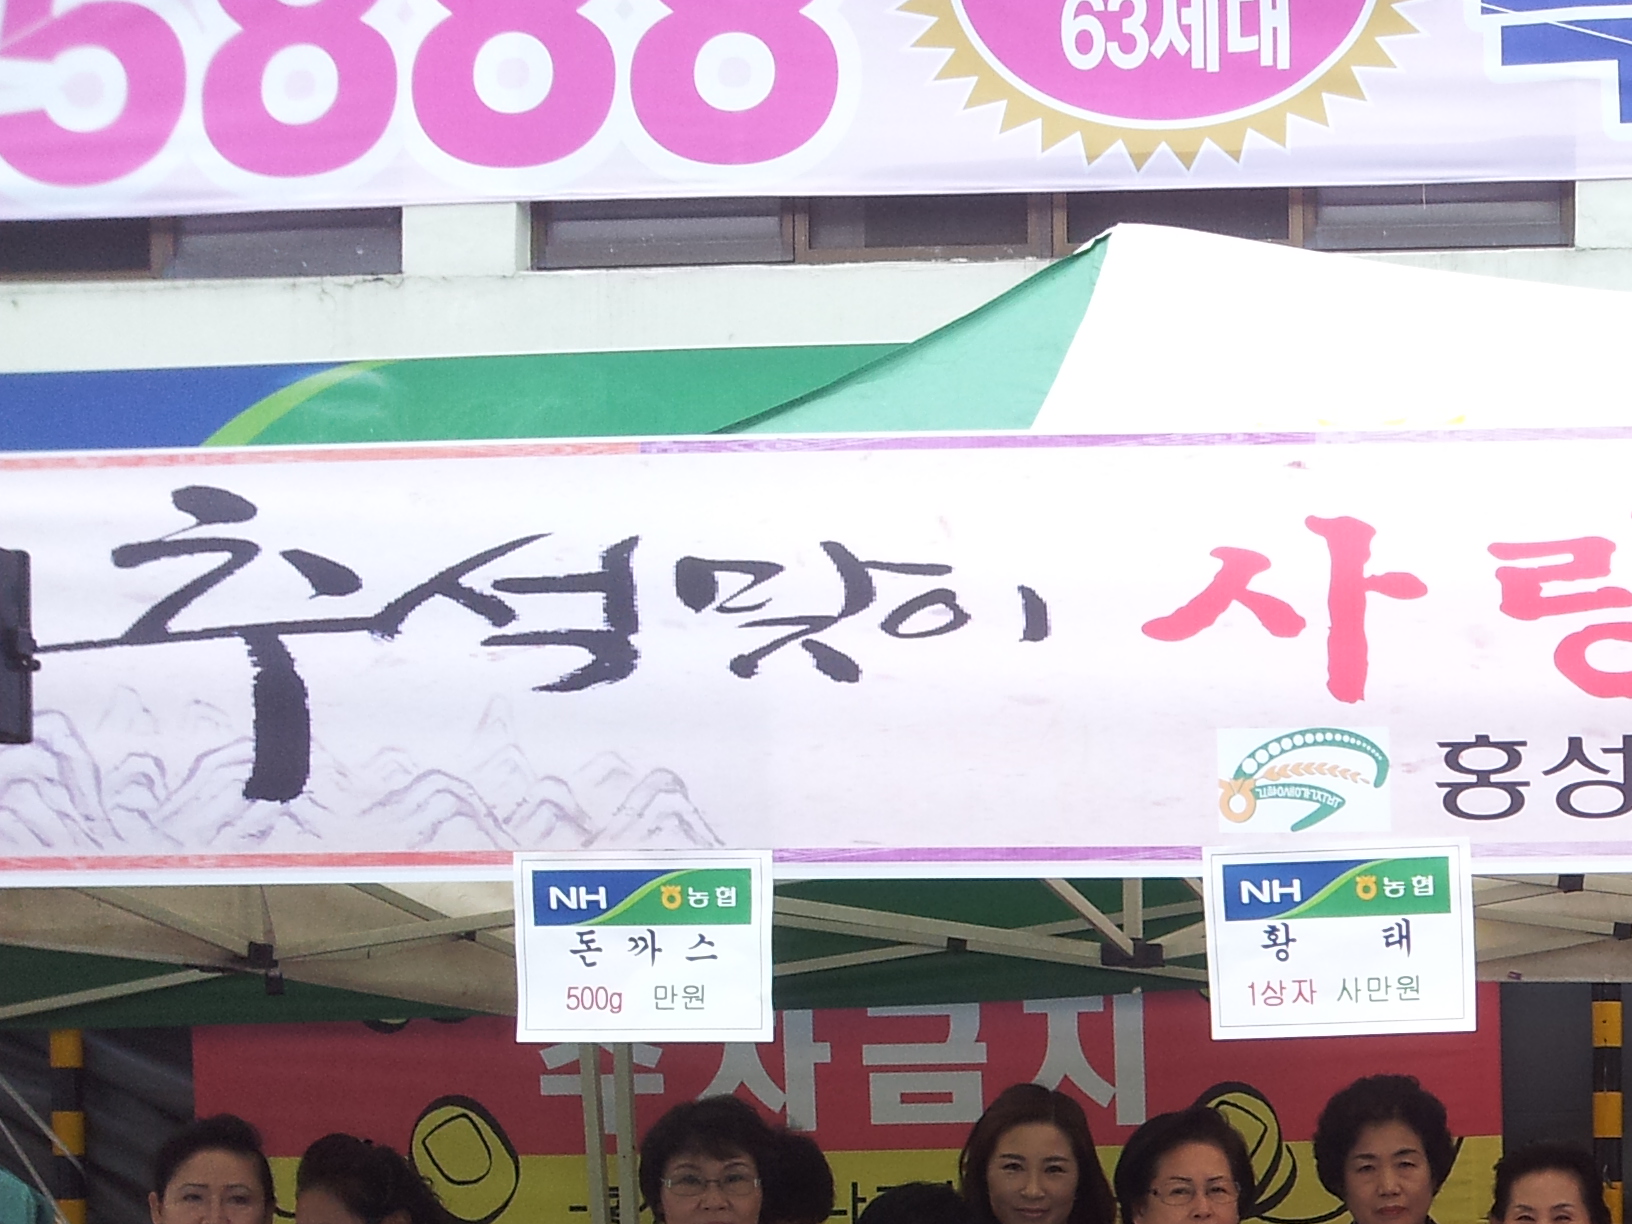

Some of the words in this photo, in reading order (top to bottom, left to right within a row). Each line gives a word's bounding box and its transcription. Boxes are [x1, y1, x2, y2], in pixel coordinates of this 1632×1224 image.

[30, 485, 1049, 802] 추석맞이
[550, 886, 607, 910] NH
[688, 887, 736, 908] 농협
[1240, 879, 1301, 904] NH
[1384, 875, 1433, 897] 농협
[566, 986, 622, 1013] 500g
[654, 985, 704, 1010] 만원
[1248, 978, 1317, 1006] 1상자
[1337, 975, 1419, 1003] 사만원
